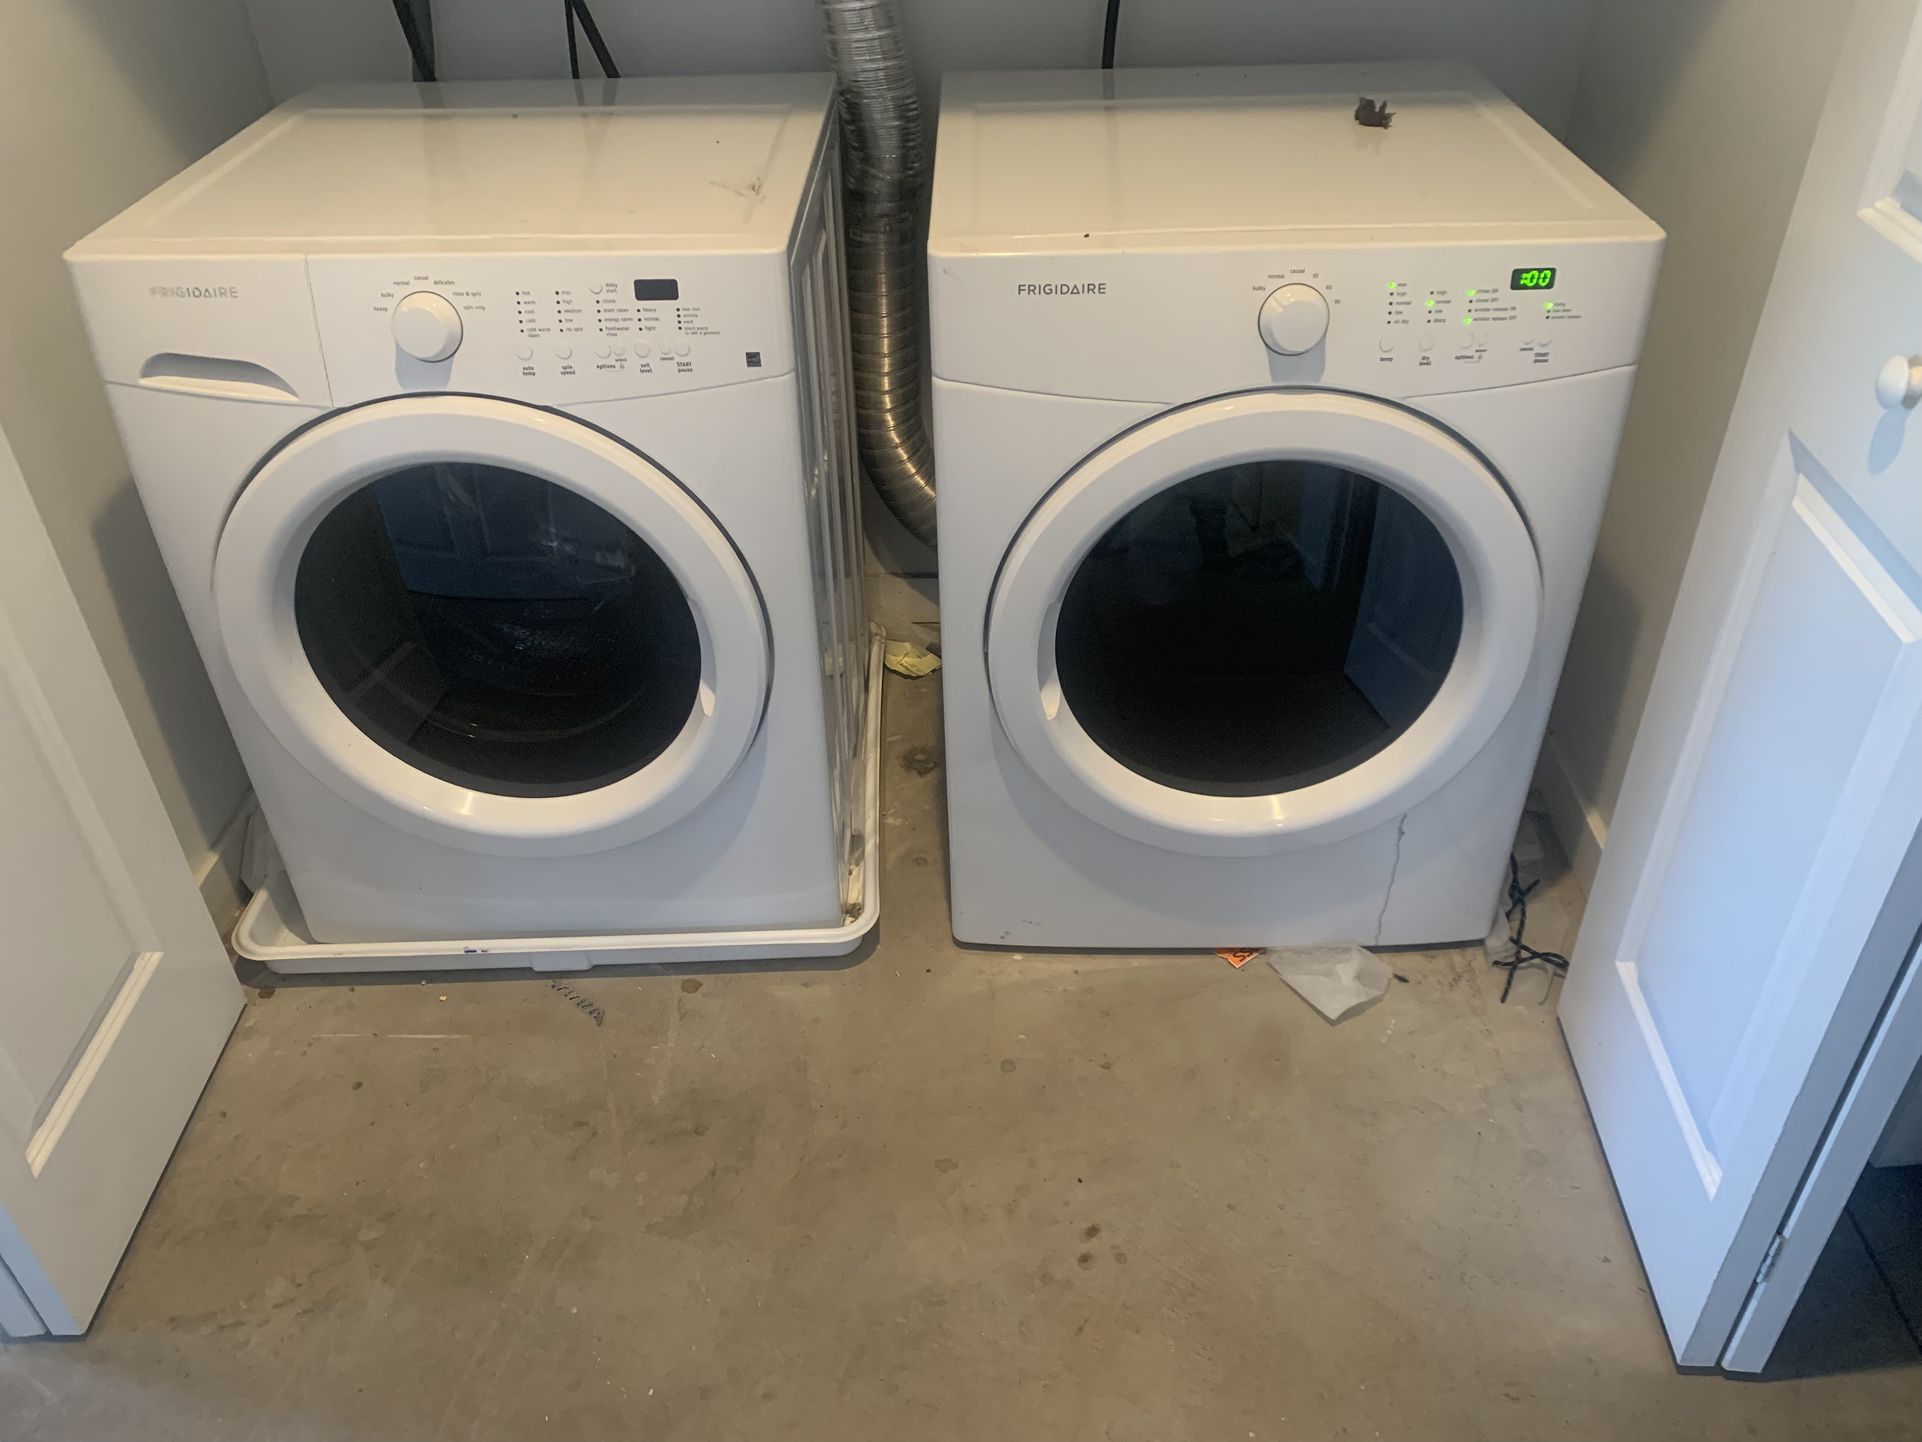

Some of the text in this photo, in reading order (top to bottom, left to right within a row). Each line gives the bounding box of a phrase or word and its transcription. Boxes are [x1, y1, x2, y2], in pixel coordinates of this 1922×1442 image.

[149, 286, 239, 298] FRIGIDAIRE
[1018, 283, 1106, 295] FRIGIDAIRE
[373, 305, 388, 313] heavy
